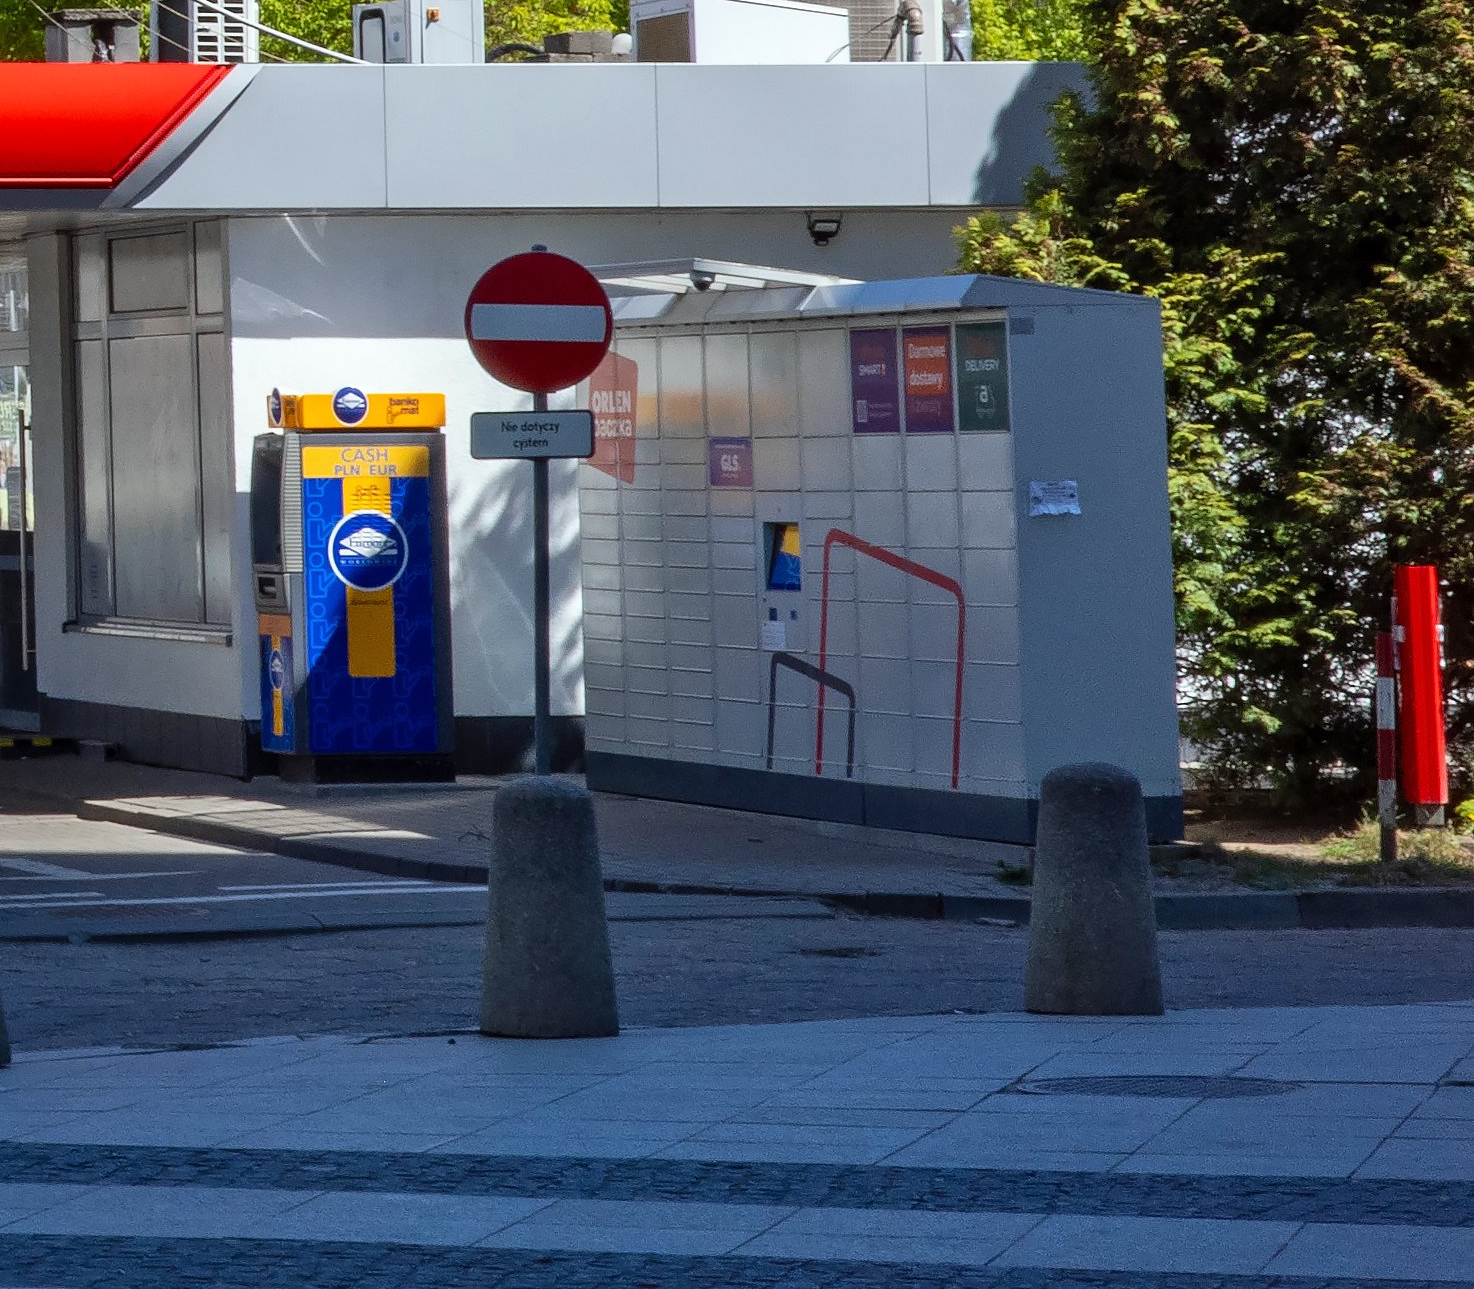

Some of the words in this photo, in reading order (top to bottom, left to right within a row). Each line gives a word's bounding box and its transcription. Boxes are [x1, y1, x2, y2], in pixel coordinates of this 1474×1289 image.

[965, 359, 1000, 372] DELIVERY
[591, 390, 632, 413] ORLEN
[501, 421, 517, 433] Nie
[521, 421, 560, 436] dotyczy
[513, 440, 549, 451] cystern
[340, 448, 389, 462] CASH
[334, 464, 361, 476] PLN
[369, 464, 398, 476] EUR
